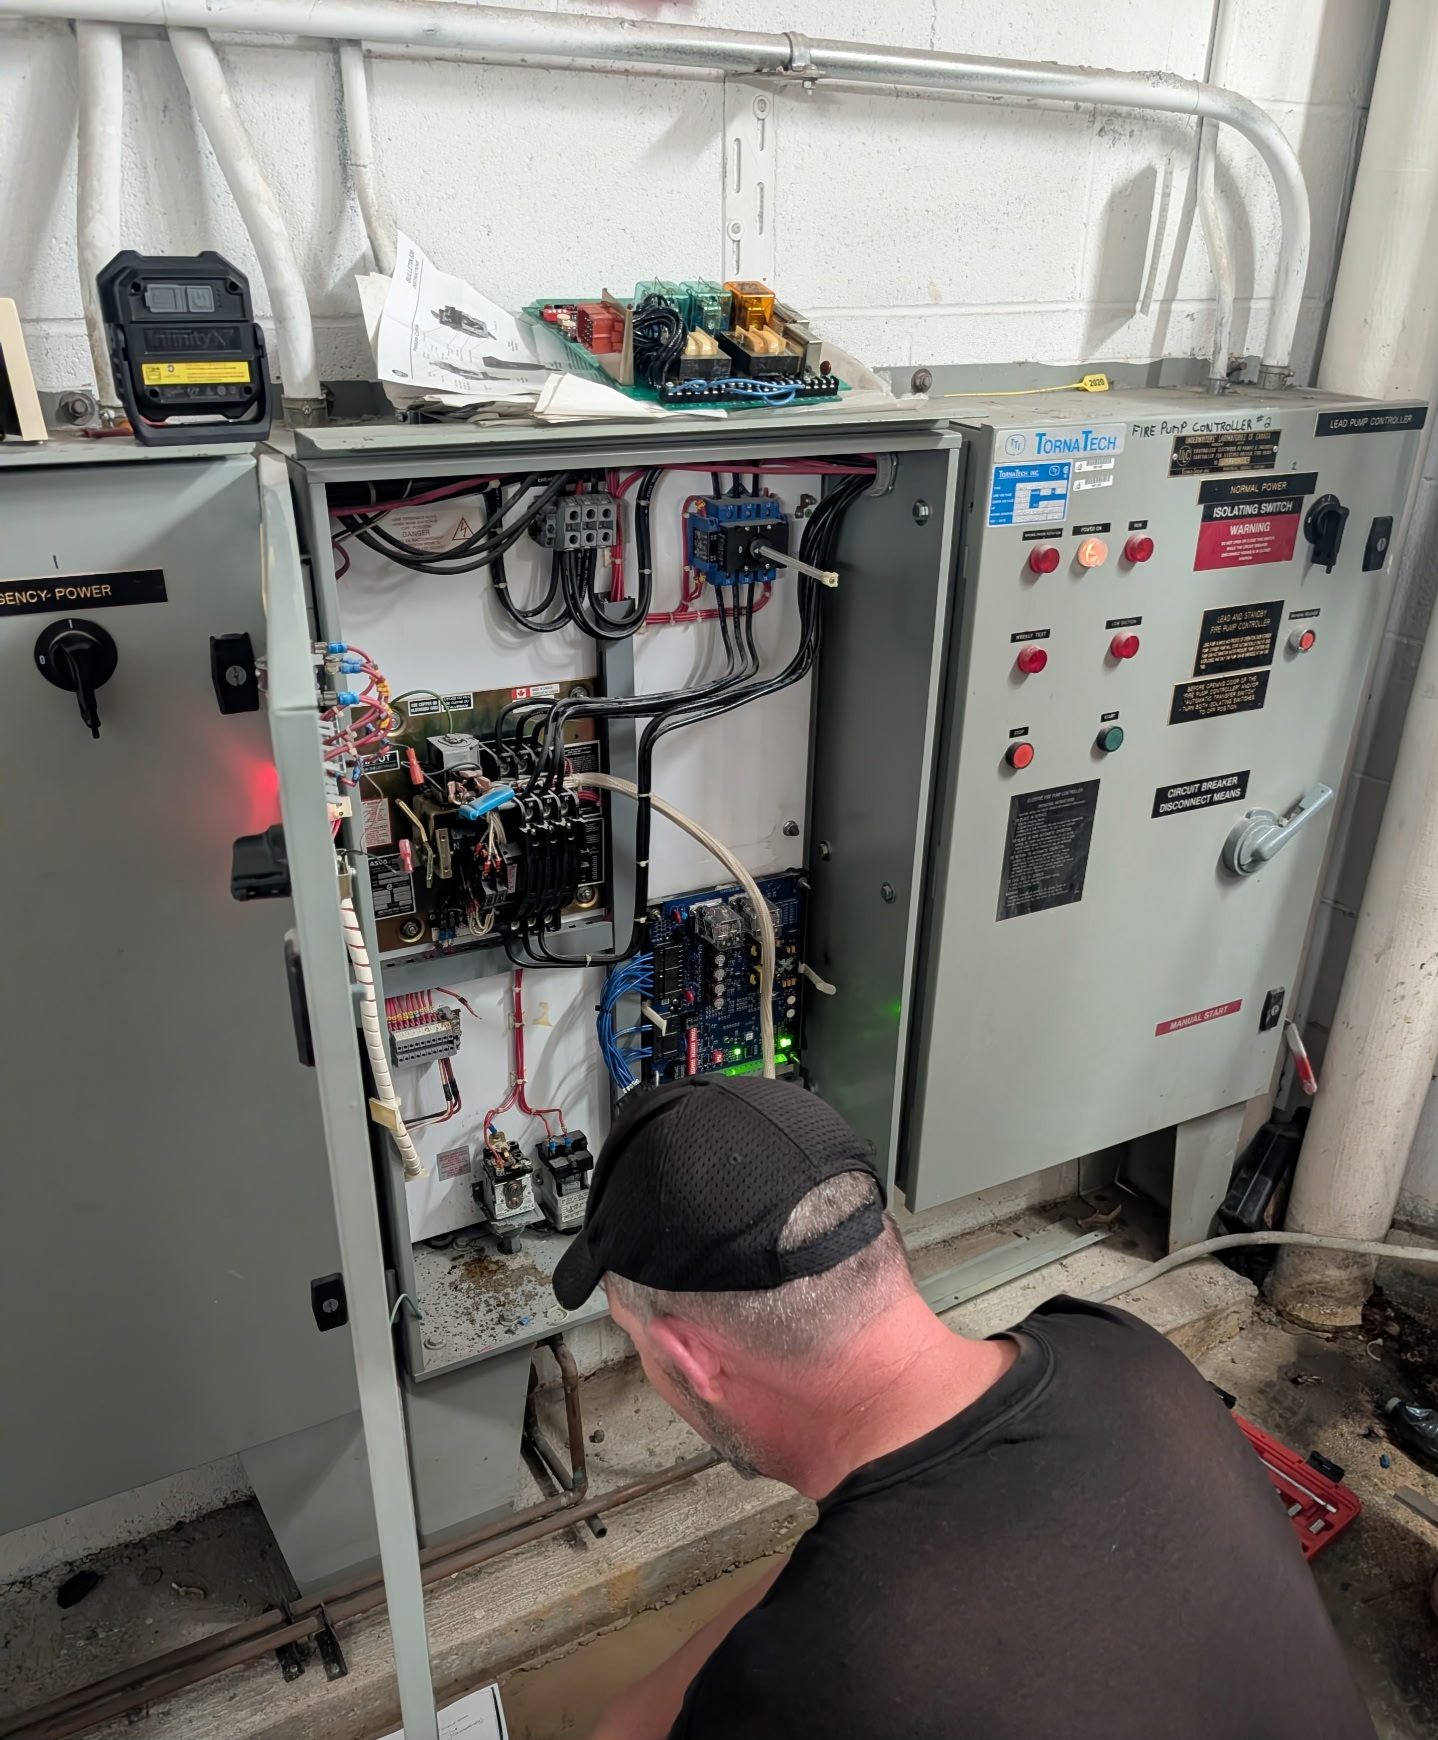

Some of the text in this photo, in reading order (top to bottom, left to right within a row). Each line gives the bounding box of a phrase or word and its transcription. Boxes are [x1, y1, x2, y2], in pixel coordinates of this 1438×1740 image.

[1089, 378, 1105, 387] 2020
[1132, 424, 1156, 438] FIRE
[1192, 419, 1252, 432] CONTROLLER
[1330, 414, 1413, 428] LEAD PUMP CONTROLLER
[1230, 482, 1288, 494] NORMAL POWER
[1213, 501, 1293, 518] ISOLATING SWITCH
[402, 529, 430, 537] DANGER
[1230, 522, 1271, 536] WARNING
[55, 584, 112, 600] POWER
[1217, 610, 1267, 624] LEAD AND STANDBY
[1210, 619, 1270, 634] FIRE PUMP CONTROLLER
[1168, 776, 1238, 798] CIRCUIT BREAKER
[1159, 788, 1241, 813] DISCONNECT MEANS
[1170, 1005, 1229, 1030] MANUAL START
